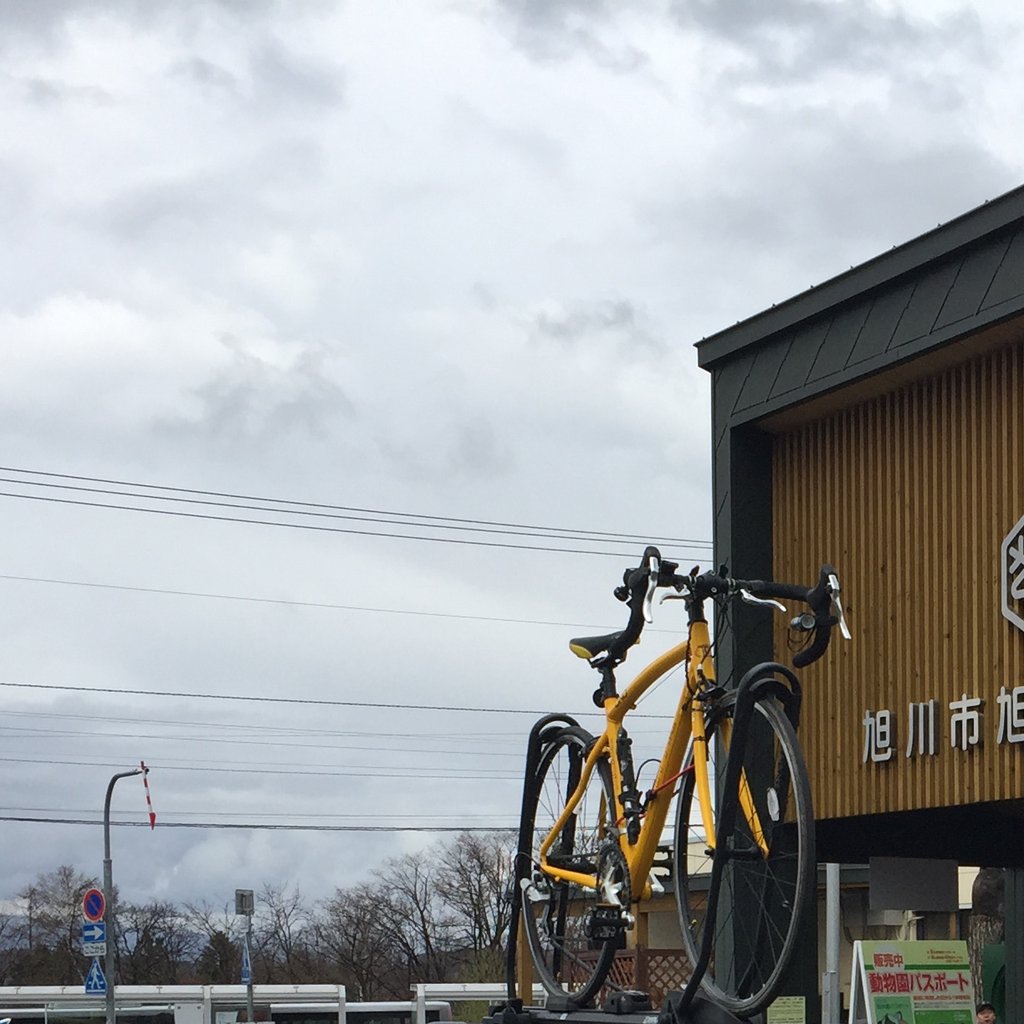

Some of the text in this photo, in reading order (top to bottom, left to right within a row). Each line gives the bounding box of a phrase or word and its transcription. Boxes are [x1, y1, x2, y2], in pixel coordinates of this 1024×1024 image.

[873, 953, 903, 968] 販売中
[868, 972, 969, 993] 動物園パスポート
